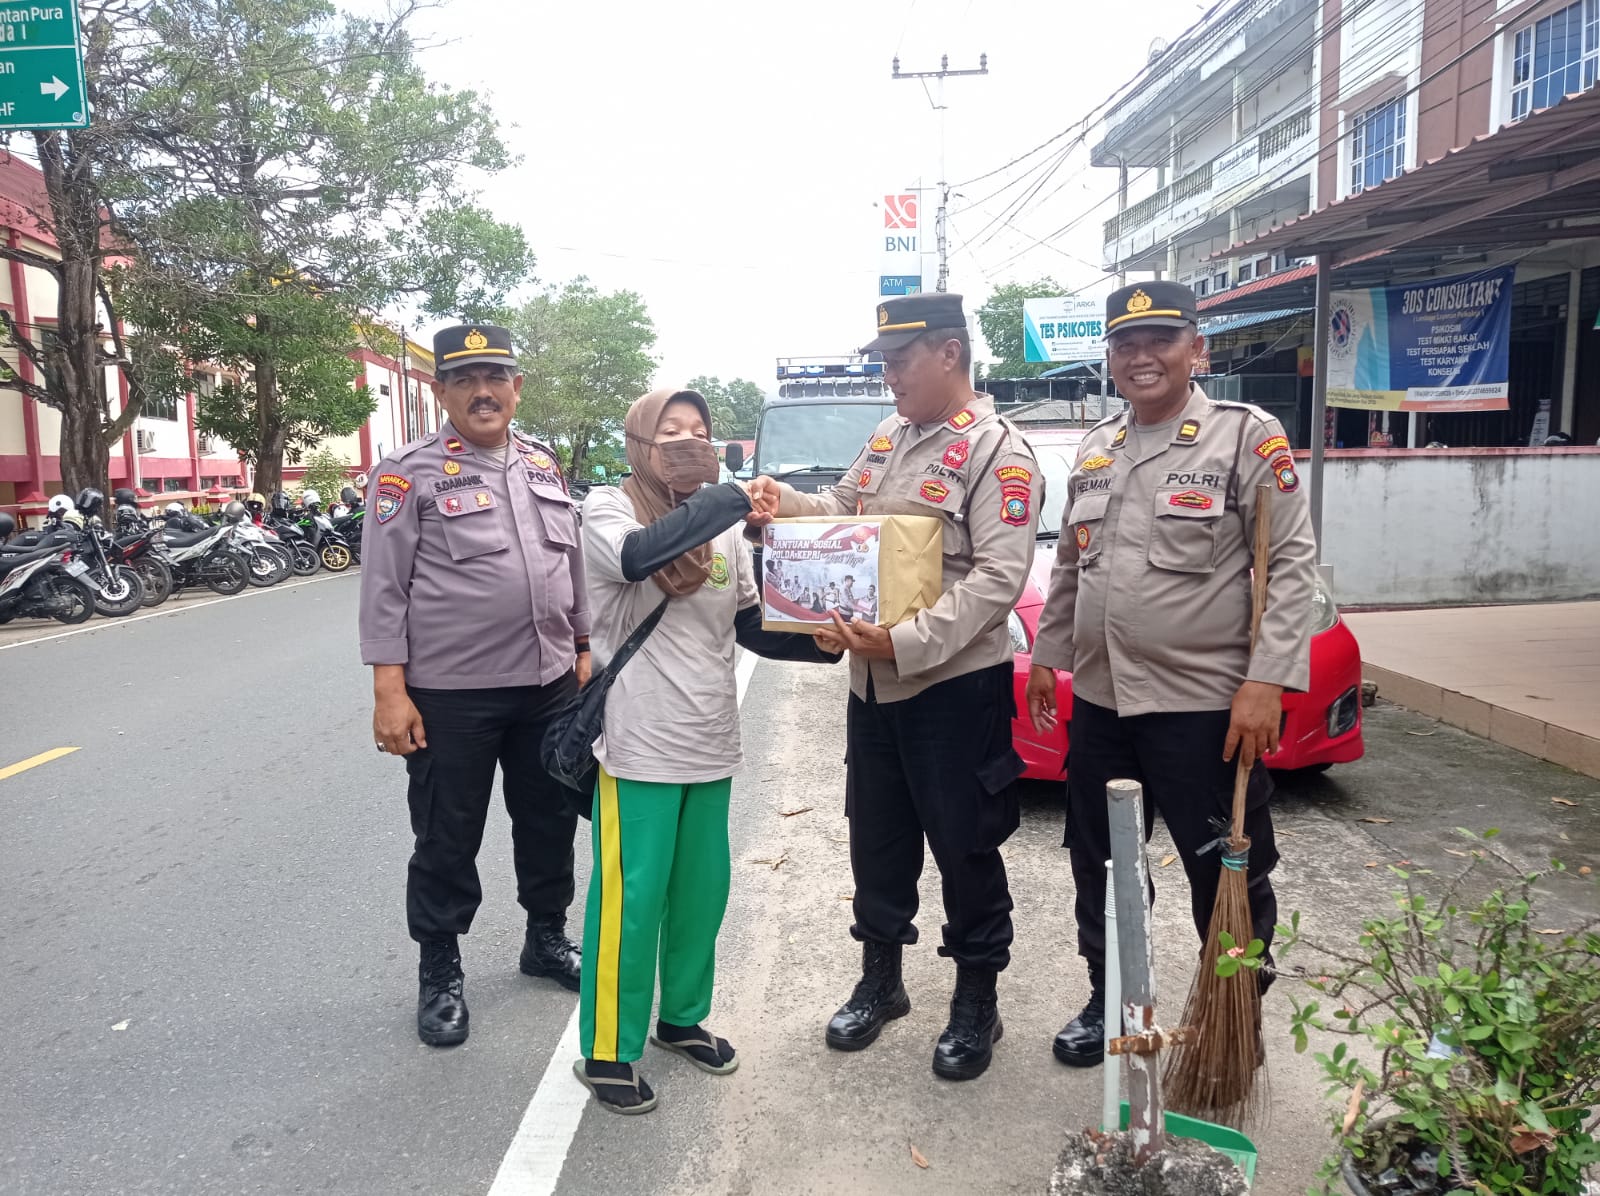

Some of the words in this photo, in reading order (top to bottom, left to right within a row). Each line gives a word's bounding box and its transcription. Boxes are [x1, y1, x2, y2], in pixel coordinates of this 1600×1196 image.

[31, 7, 64, 21] Pura
[885, 236, 916, 251] BNI
[882, 279, 903, 287] ATM
[1402, 288, 1424, 314] 3DS
[1425, 278, 1504, 312] CONSULTANT
[1040, 322, 1055, 339] TES
[1057, 320, 1102, 338] PSIKOTES
[1417, 336, 1432, 345] TEST
[1453, 333, 1478, 343] BAKAT
[1406, 348, 1420, 356] TEST
[1420, 357, 1435, 366] TEST
[924, 463, 962, 483] POLRI
[1166, 473, 1220, 488] POLRI
[817, 484, 834, 493] IS
[772, 540, 810, 549] BANTUAN
[812, 540, 843, 549] SOSIAL
[771, 550, 796, 560] POLDA
[796, 550, 821, 560] KEPRI
